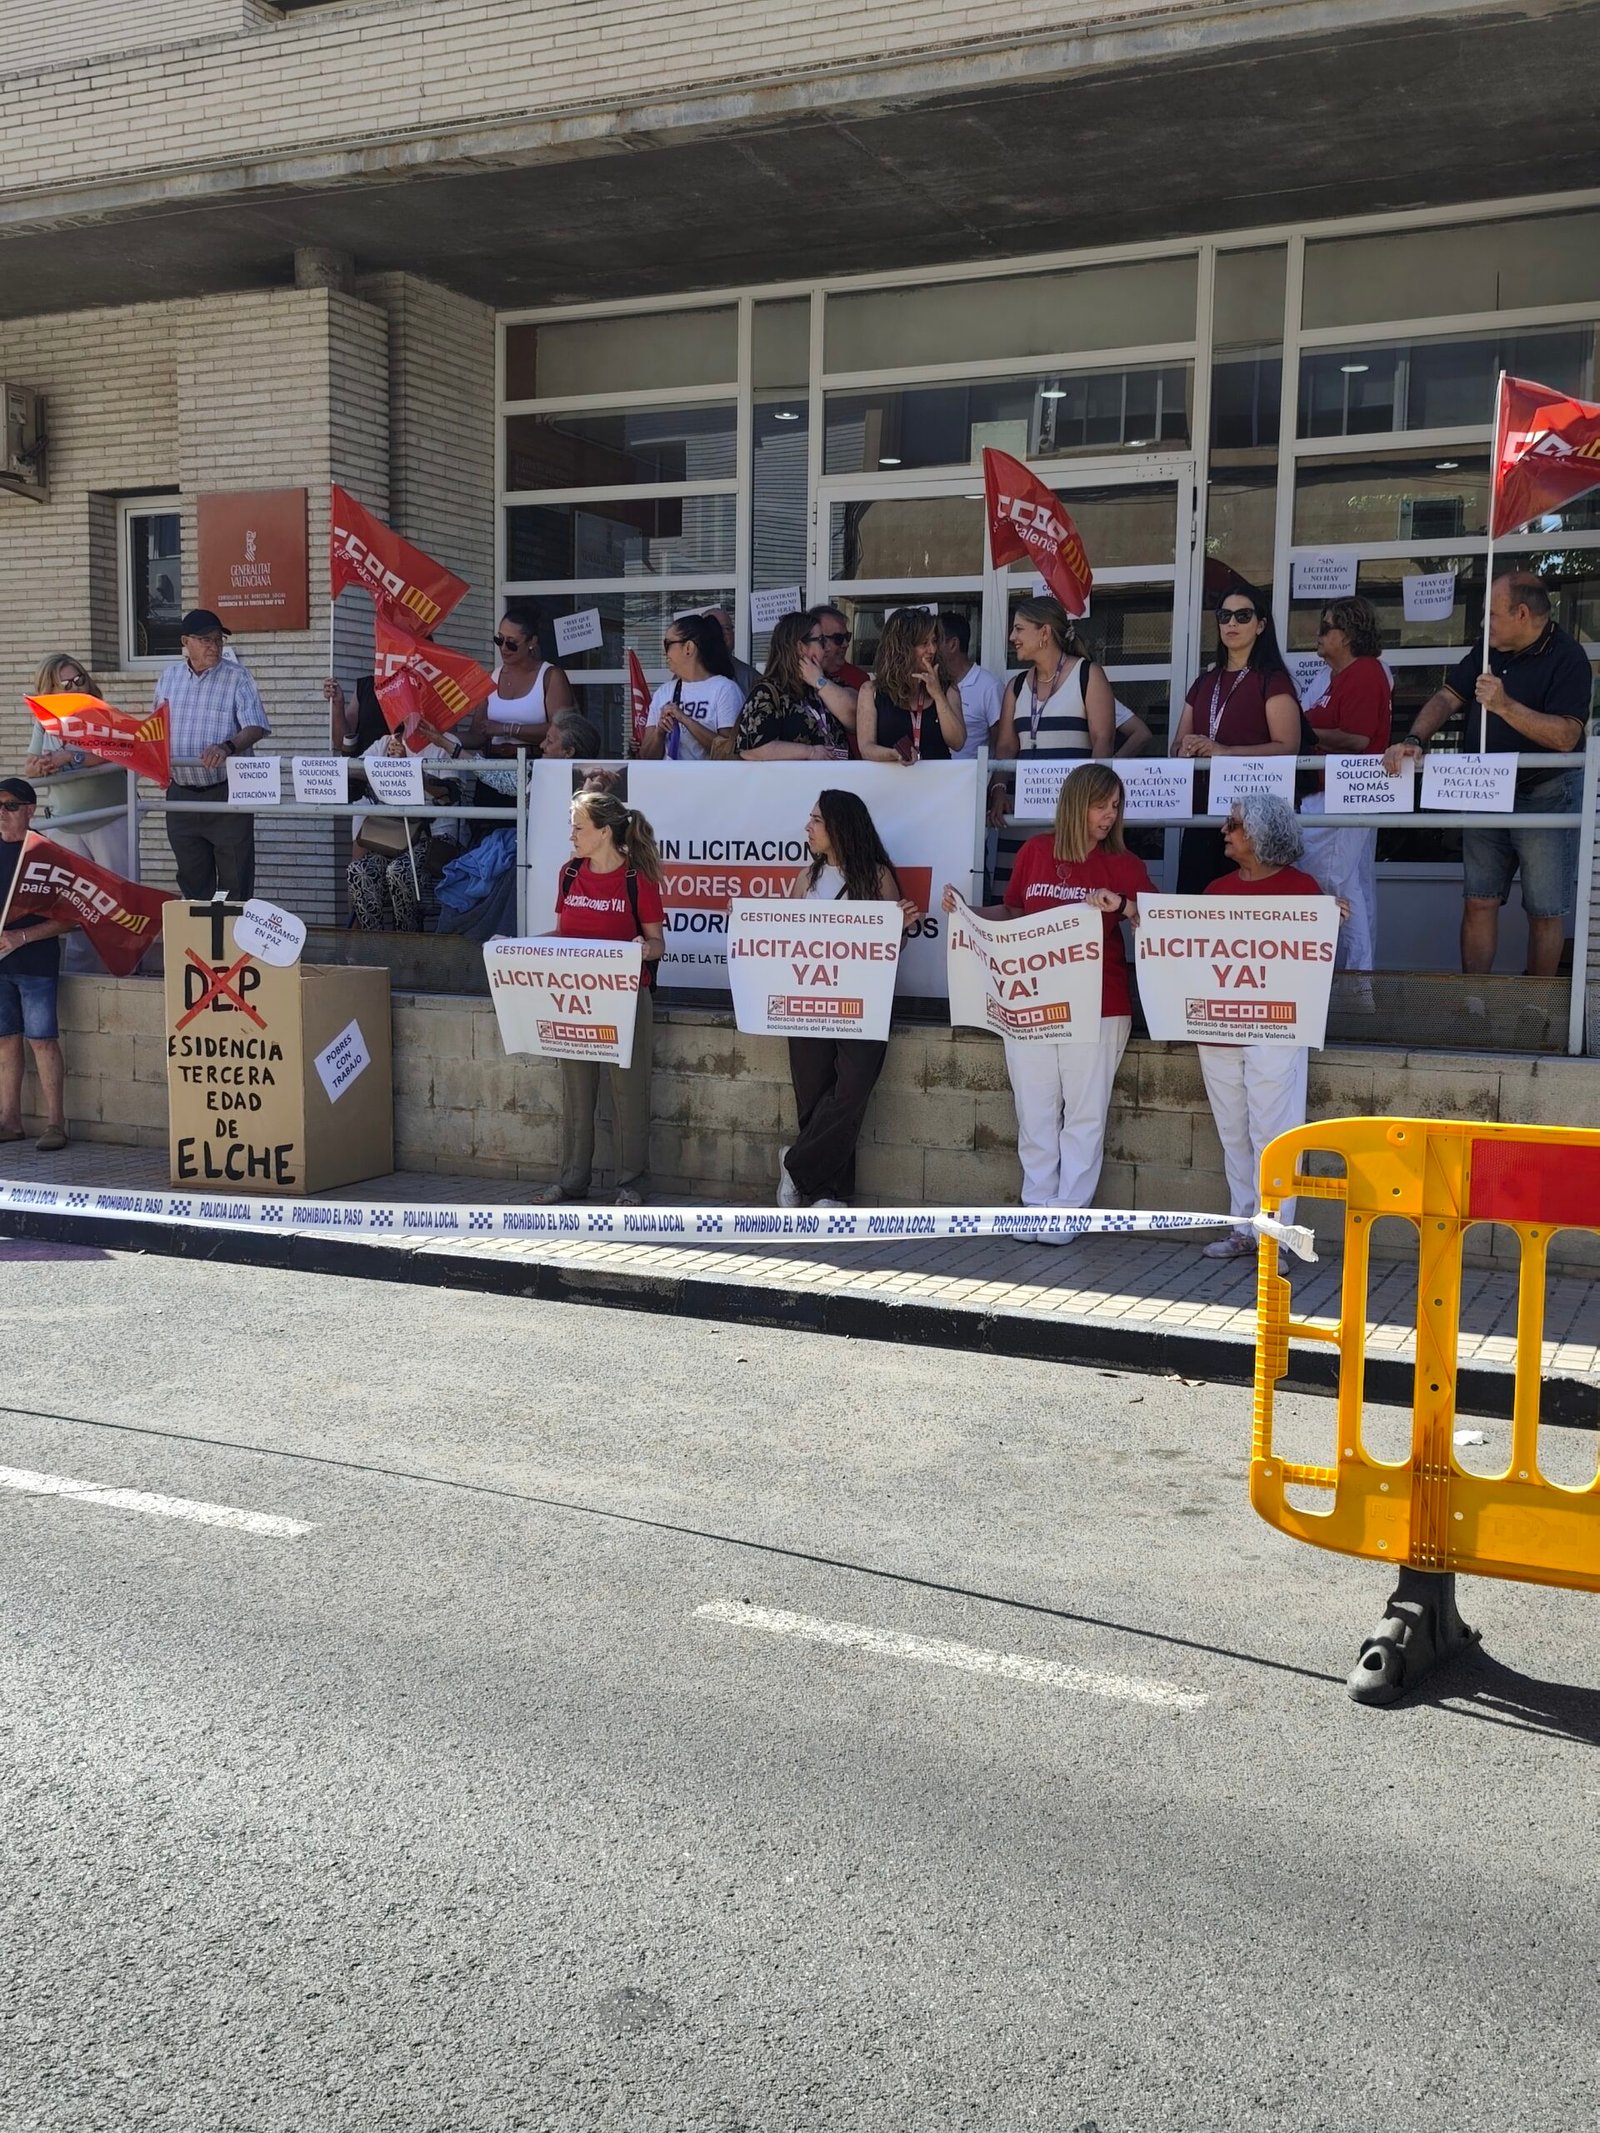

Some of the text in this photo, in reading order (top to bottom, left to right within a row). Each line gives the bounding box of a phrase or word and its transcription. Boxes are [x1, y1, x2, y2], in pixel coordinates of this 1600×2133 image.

[997, 494, 1068, 544] CCOO
[230, 563, 271, 576] GENERALITAT
[231, 575, 272, 588] VALENCIANA
[767, 591, 797, 601] CONTRATO
[1415, 588, 1446, 597] CUIDAR
[756, 601, 787, 610] CADUCADO
[235, 762, 271, 770] CONTRATO
[301, 760, 338, 768] QUEREMOS
[1432, 765, 1510, 777] VOCACIÓN NO
[239, 772, 268, 780] VENCIDO
[299, 770, 341, 778] SOLUCIONES,
[1170, 777, 1187, 786] NO
[1223, 772, 1283, 782] LICITACIÓN
[316, 778, 333, 786] MÁS
[380, 779, 406, 788] NO MÁS
[1233, 785, 1271, 794] NO HAY
[1348, 780, 1389, 791] NO MÁS
[1443, 778, 1496, 788] PAGA LAS
[232, 789, 277, 799] LICITACIÓN YA
[304, 788, 337, 797] RETRASOS
[1025, 787, 1054, 795] PUEDE
[1130, 788, 1176, 797] PAGA LAS
[1343, 794, 1396, 804] RETRASOS
[24, 862, 119, 916] CCOO
[1026, 883, 1086, 900] ¡LICITACIONES
[55, 886, 101, 924] valencià
[611, 898, 626, 913] YA!
[270, 913, 283, 924] NO
[740, 911, 885, 925] GESTIONES INTEGRALES
[1147, 909, 1318, 922] GESTIONES INTEGRALES
[245, 911, 300, 944] DESCANSAMOS
[995, 918, 1081, 944] INTEGRALES
[254, 927, 282, 946] EN PAZ
[495, 945, 624, 959] GESTIONES INTEGRALES
[731, 938, 898, 961] ¡LICITACIONES
[1140, 938, 1334, 962] ¡LICITACIONES
[681, 953, 712, 964] DE LA
[492, 969, 640, 992] ¡LICITACIONES
[791, 963, 839, 987] YA!
[1211, 964, 1267, 989] YA!
[992, 976, 1039, 1001] YA!
[550, 993, 593, 1015] YA!
[790, 999, 839, 1015] CCOO
[1210, 1004, 1269, 1019] CCOO
[767, 1015, 795, 1023] federació
[1186, 1020, 1218, 1028] federació
[1260, 1023, 1288, 1031] sectors
[554, 1025, 598, 1040] CCOO
[766, 1023, 810, 1031] sociosanitaris
[836, 1025, 863, 1033] Valencià
[1038, 1024, 1065, 1032] sectors
[1044, 1031, 1073, 1039] Valencià
[1187, 1029, 1235, 1038] sociosanitaris
[1235, 1030, 1247, 1038] del
[1265, 1031, 1296, 1040] Valencià
[326, 1034, 352, 1064] POBRES
[540, 1038, 563, 1047] federació
[570, 1041, 589, 1049] sanitat
[335, 1050, 352, 1070] CON
[178, 1065, 275, 1085] TERCERA
[332, 1054, 363, 1089] TRABAJO
[206, 1091, 262, 1111] EDAD
[215, 1118, 239, 1139] DE
[177, 1137, 296, 1185] ELCHE
[9, 1188, 59, 1206] POLICIA LOCAL
[96, 1194, 164, 1214] PROHIBIDO EL PASO
[200, 1201, 252, 1220] POLICIA LOCAL
[292, 1206, 363, 1226] PROHIBIDO EL PASO
[403, 1210, 459, 1229] POLICIA LOCAL
[503, 1212, 580, 1231] PROHIBIDO EL PASO
[624, 1214, 685, 1232] POLICIA LOCAL
[734, 1215, 820, 1233] PROHIBIDO EL PASO
[867, 1215, 936, 1233] POLICIA LOCAL
[991, 1214, 1092, 1233] PROHIBIDO EL PASO
